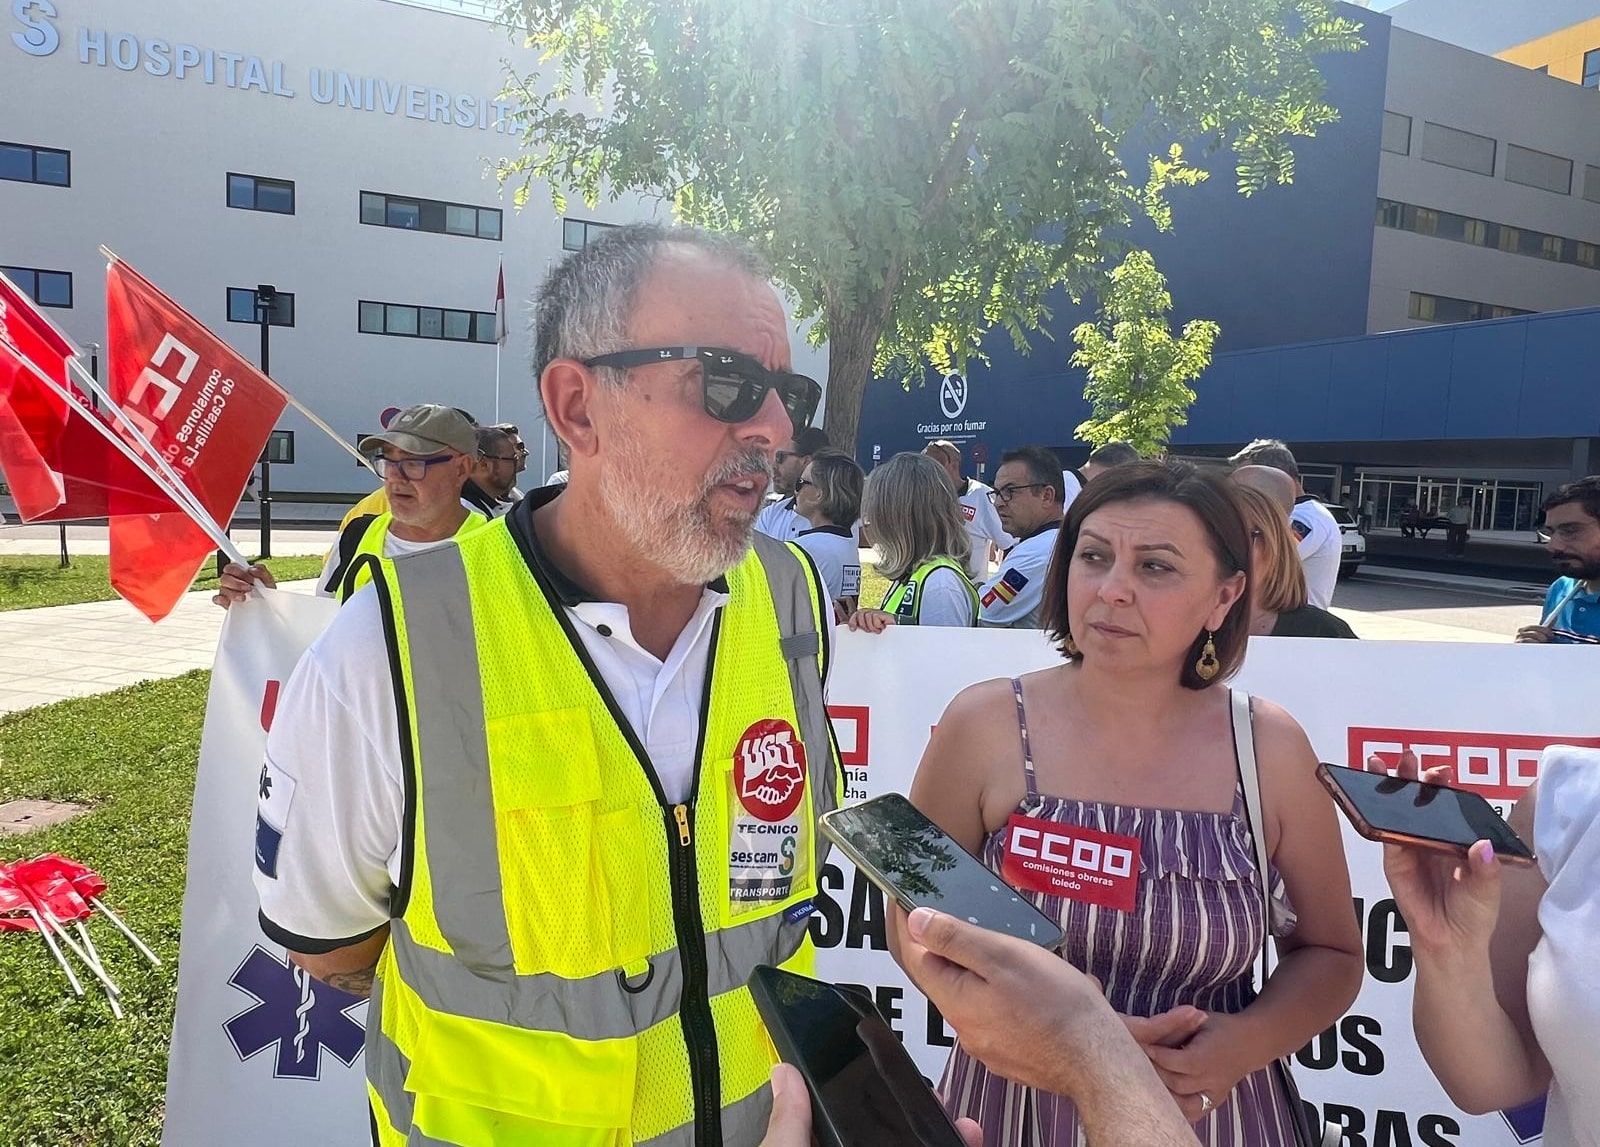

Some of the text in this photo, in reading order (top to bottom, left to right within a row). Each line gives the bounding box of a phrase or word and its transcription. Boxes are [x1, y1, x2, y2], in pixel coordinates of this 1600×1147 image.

[79, 27, 296, 99] HOSPITAL
[310, 68, 548, 140] UNIVERSITA
[917, 419, 987, 435] Gracias por no fumar
[742, 731, 796, 770] UGT
[737, 823, 799, 834] TECNICO
[730, 851, 778, 863] sescam
[1010, 826, 1133, 878] CCOO
[1023, 861, 1114, 887] comisiones obreras
[1051, 877, 1081, 891] toledo
